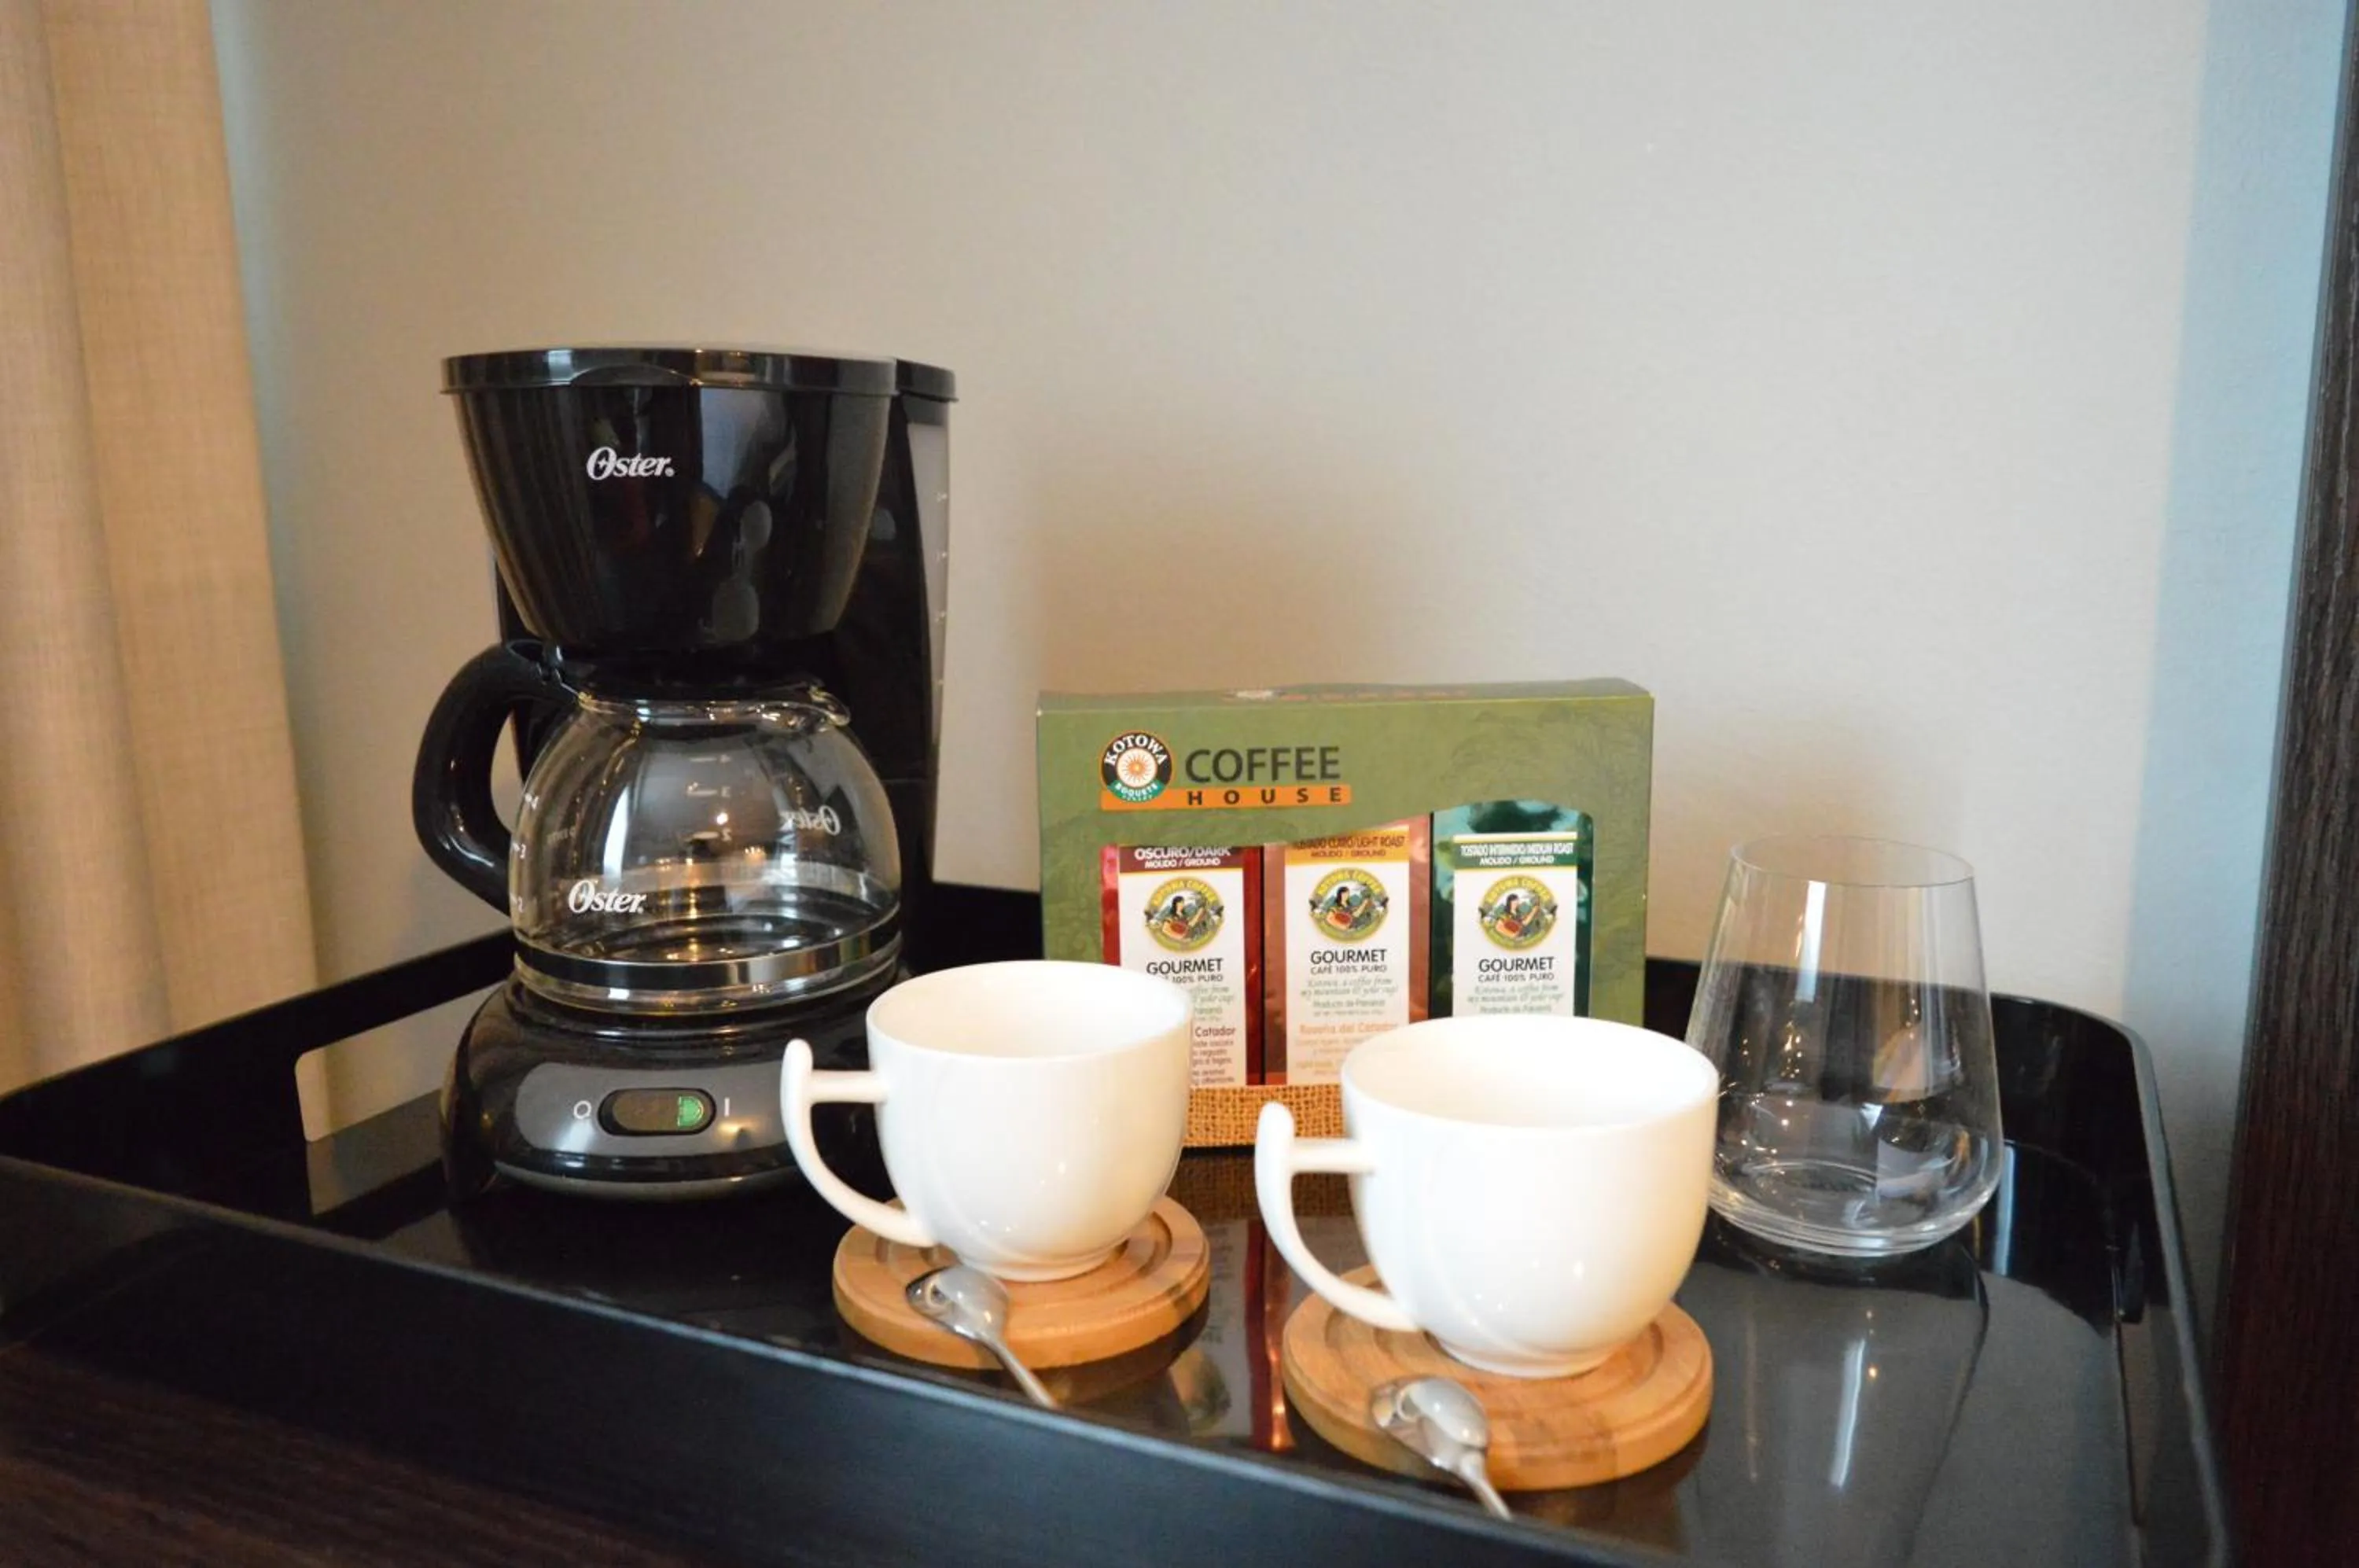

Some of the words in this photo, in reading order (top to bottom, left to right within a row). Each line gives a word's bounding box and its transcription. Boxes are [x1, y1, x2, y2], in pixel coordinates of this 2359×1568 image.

[1104, 734, 1168, 765] KOTOWA
[1185, 747, 1341, 782] COFFEE
[1187, 788, 1342, 805] HOUSE
[1310, 948, 1387, 965] GOURMET
[1478, 956, 1555, 973] GOURMET
[1146, 958, 1224, 975] GOURMET
[1361, 964, 1388, 974] PURO
[1529, 972, 1555, 981] PURO
[1194, 1025, 1236, 1038] Catador
